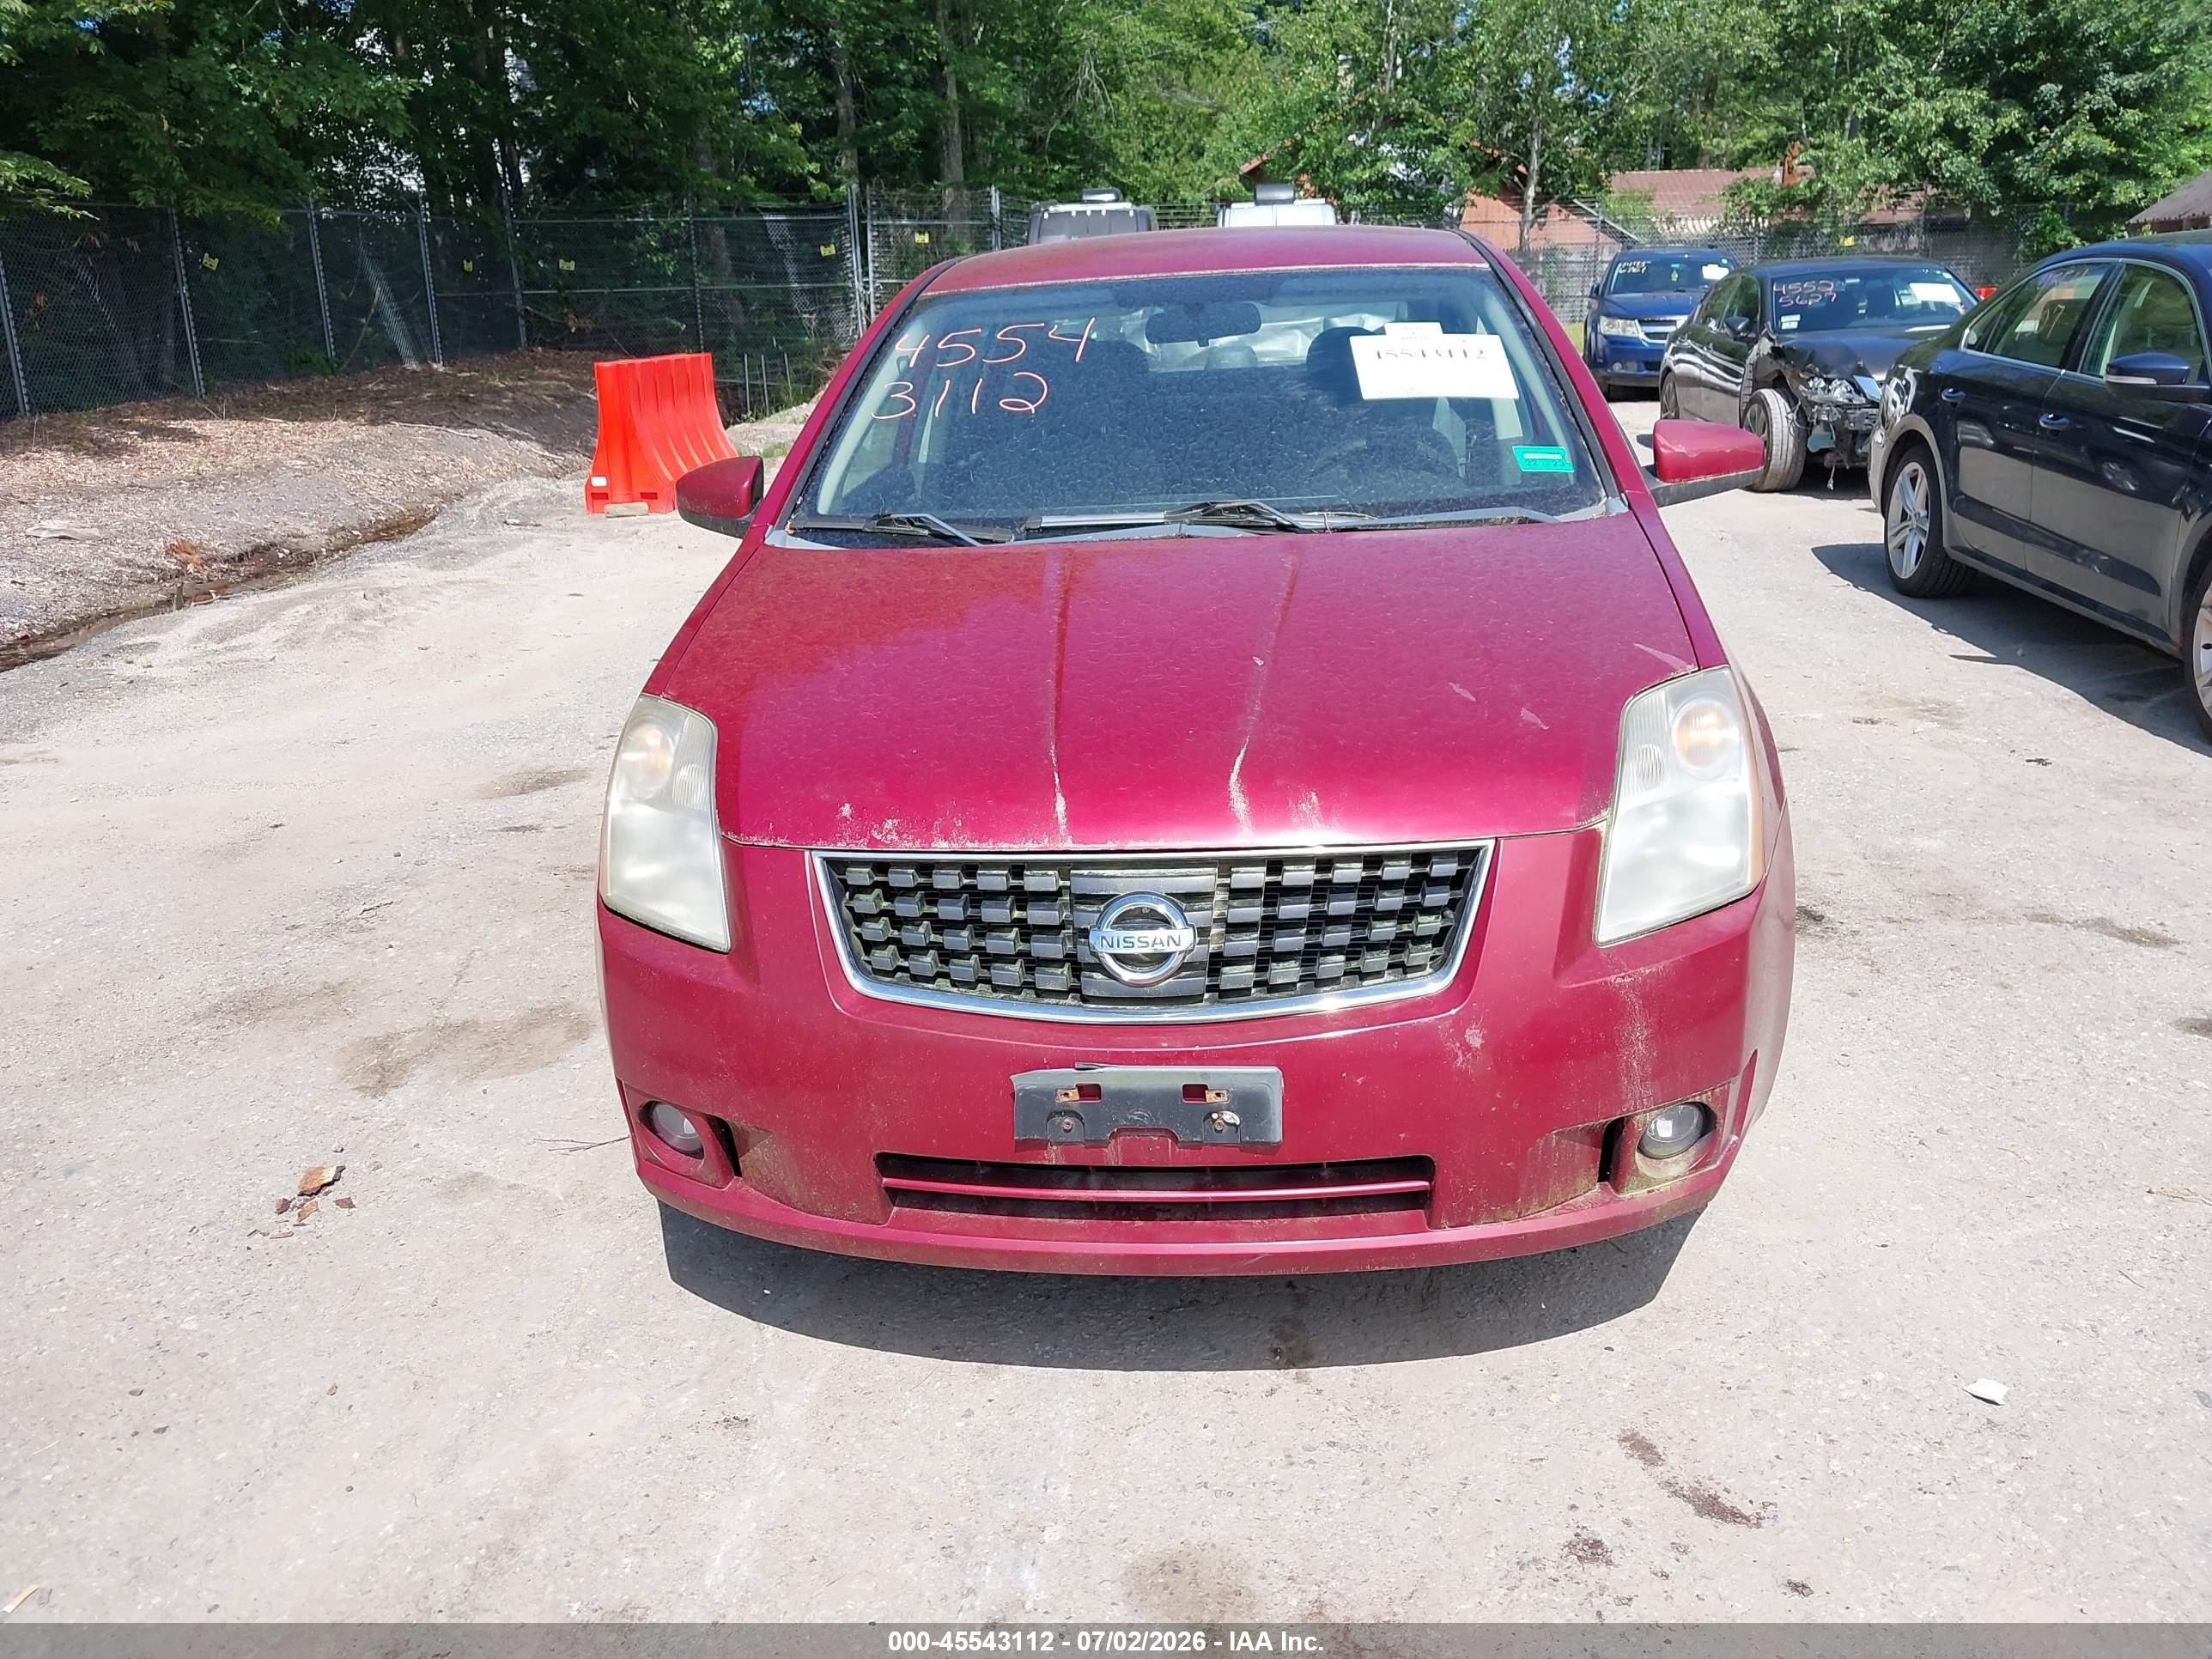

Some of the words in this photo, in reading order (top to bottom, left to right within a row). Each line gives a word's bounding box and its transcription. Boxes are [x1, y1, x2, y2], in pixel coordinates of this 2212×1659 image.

[1773, 280, 1833, 295] 4552
[895, 317, 1097, 368] 4554
[872, 372, 1049, 419] 3112
[1100, 933, 1182, 949] NISSAN
